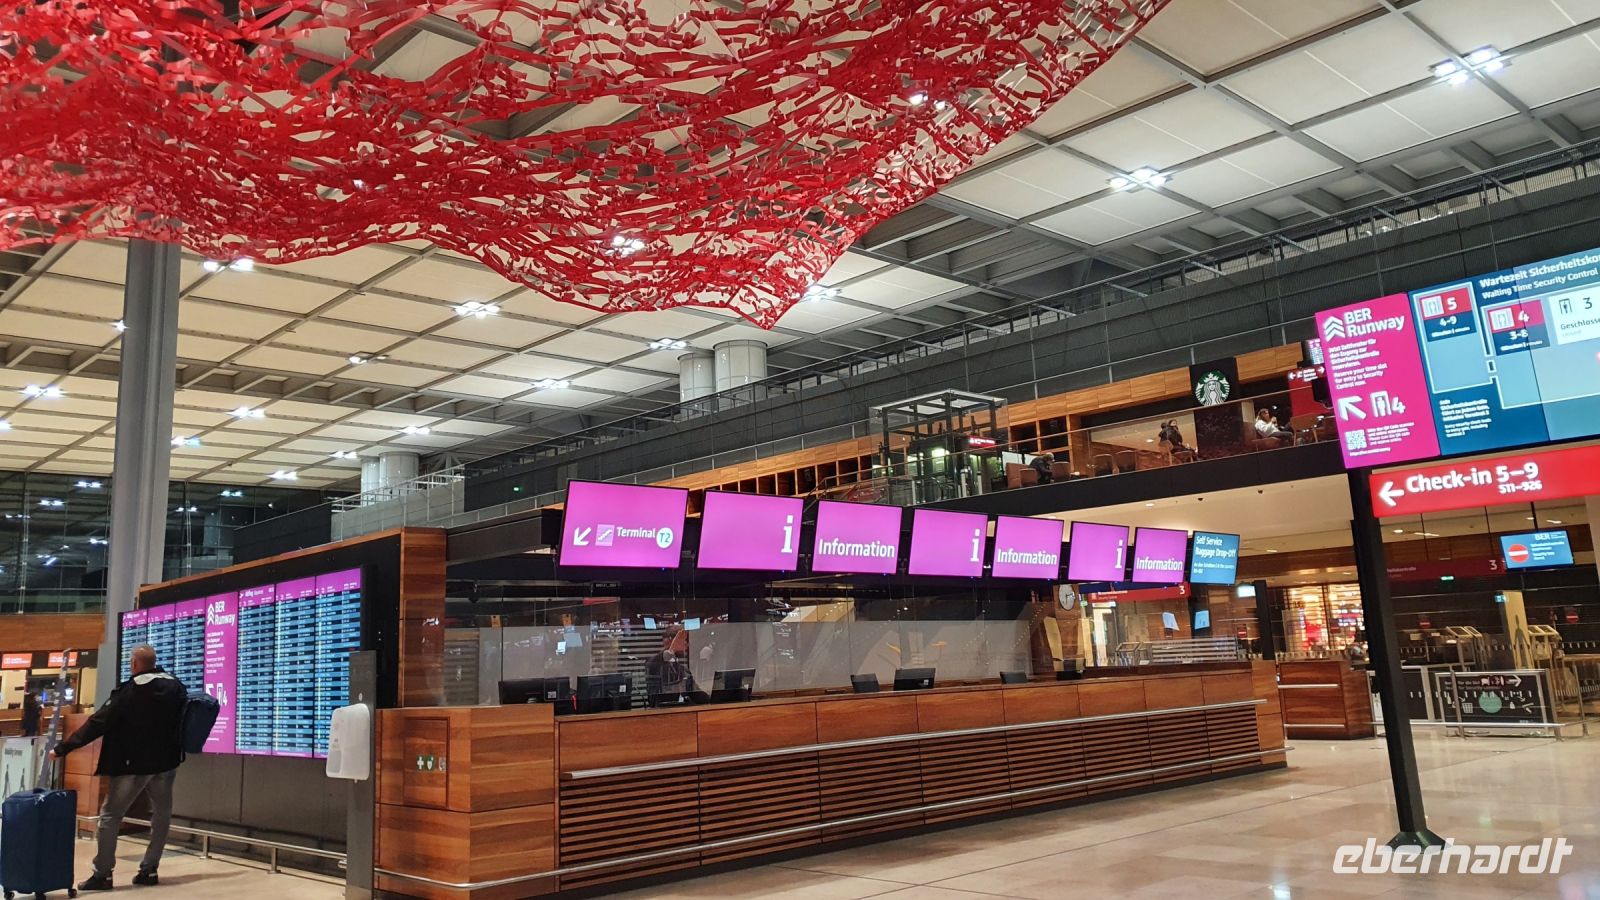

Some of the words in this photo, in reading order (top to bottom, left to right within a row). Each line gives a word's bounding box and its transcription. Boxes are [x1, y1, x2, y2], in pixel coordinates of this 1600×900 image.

[1479, 271, 1528, 288] Wartezeit
[1481, 287, 1512, 299] Waiting
[1512, 282, 1532, 292] Time
[1533, 275, 1566, 289] Security
[1567, 267, 1599, 281] Control
[1447, 296, 1457, 310] 5
[1582, 296, 1593, 309] 3
[1344, 307, 1373, 324] BER
[1518, 310, 1530, 322] 4
[1346, 315, 1405, 338] Runway
[1392, 396, 1406, 414] 4
[1405, 467, 1493, 493] Check-in
[616, 526, 656, 539] Terminal
[659, 532, 671, 543] T2
[780, 514, 794, 554] i
[1206, 536, 1223, 546] Service
[817, 537, 896, 559] Information
[969, 528, 981, 563] i
[1114, 539, 1124, 569] i
[996, 547, 1058, 566] Information
[1135, 556, 1183, 572] Information
[1489, 559, 1498, 570] 3
[1178, 585, 1185, 595] 3
[214, 600, 225, 613] BER
[214, 613, 236, 627] Runway
